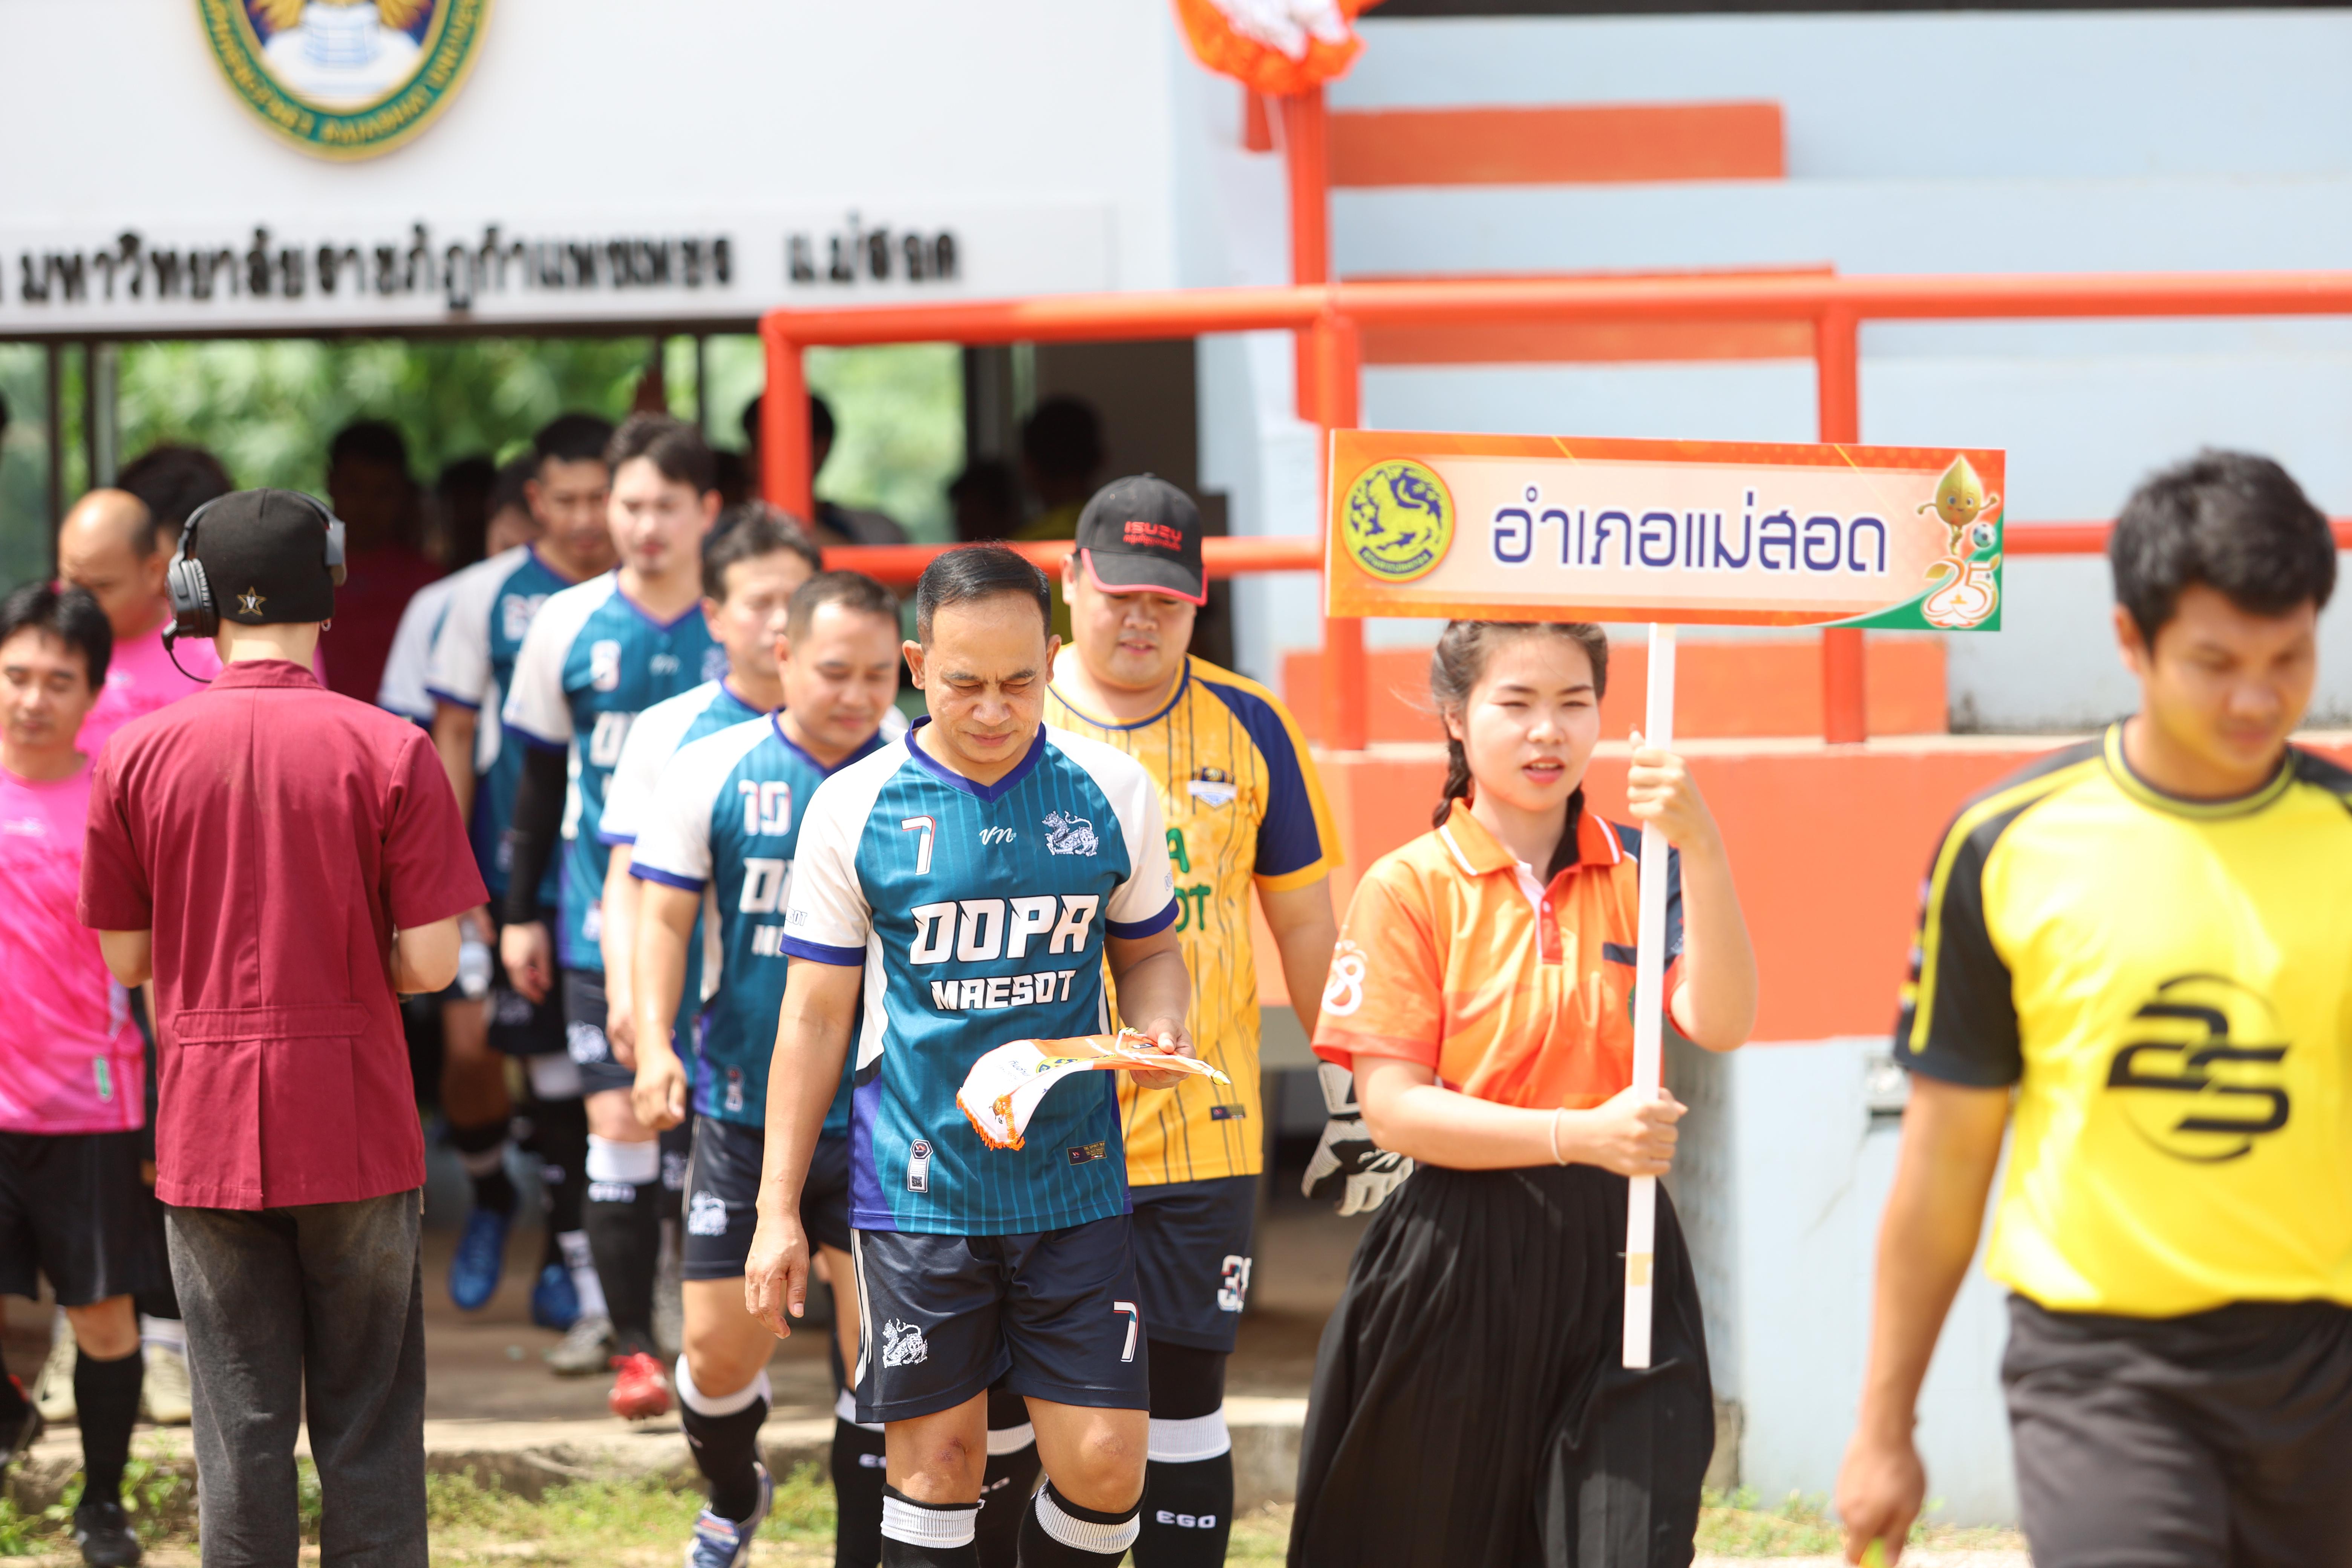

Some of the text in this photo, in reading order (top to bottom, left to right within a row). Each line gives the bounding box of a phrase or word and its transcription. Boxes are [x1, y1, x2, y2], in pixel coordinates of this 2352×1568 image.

[1124, 521, 1183, 542] ISUZU
[1493, 485, 1886, 573] อำเภอแม่สอด
[901, 815, 936, 876] 7
[909, 894, 1100, 965] DOPA
[929, 969, 1077, 1011] MAESOT
[1113, 1300, 1139, 1363] 7
[1156, 1509, 1217, 1529] EGO
